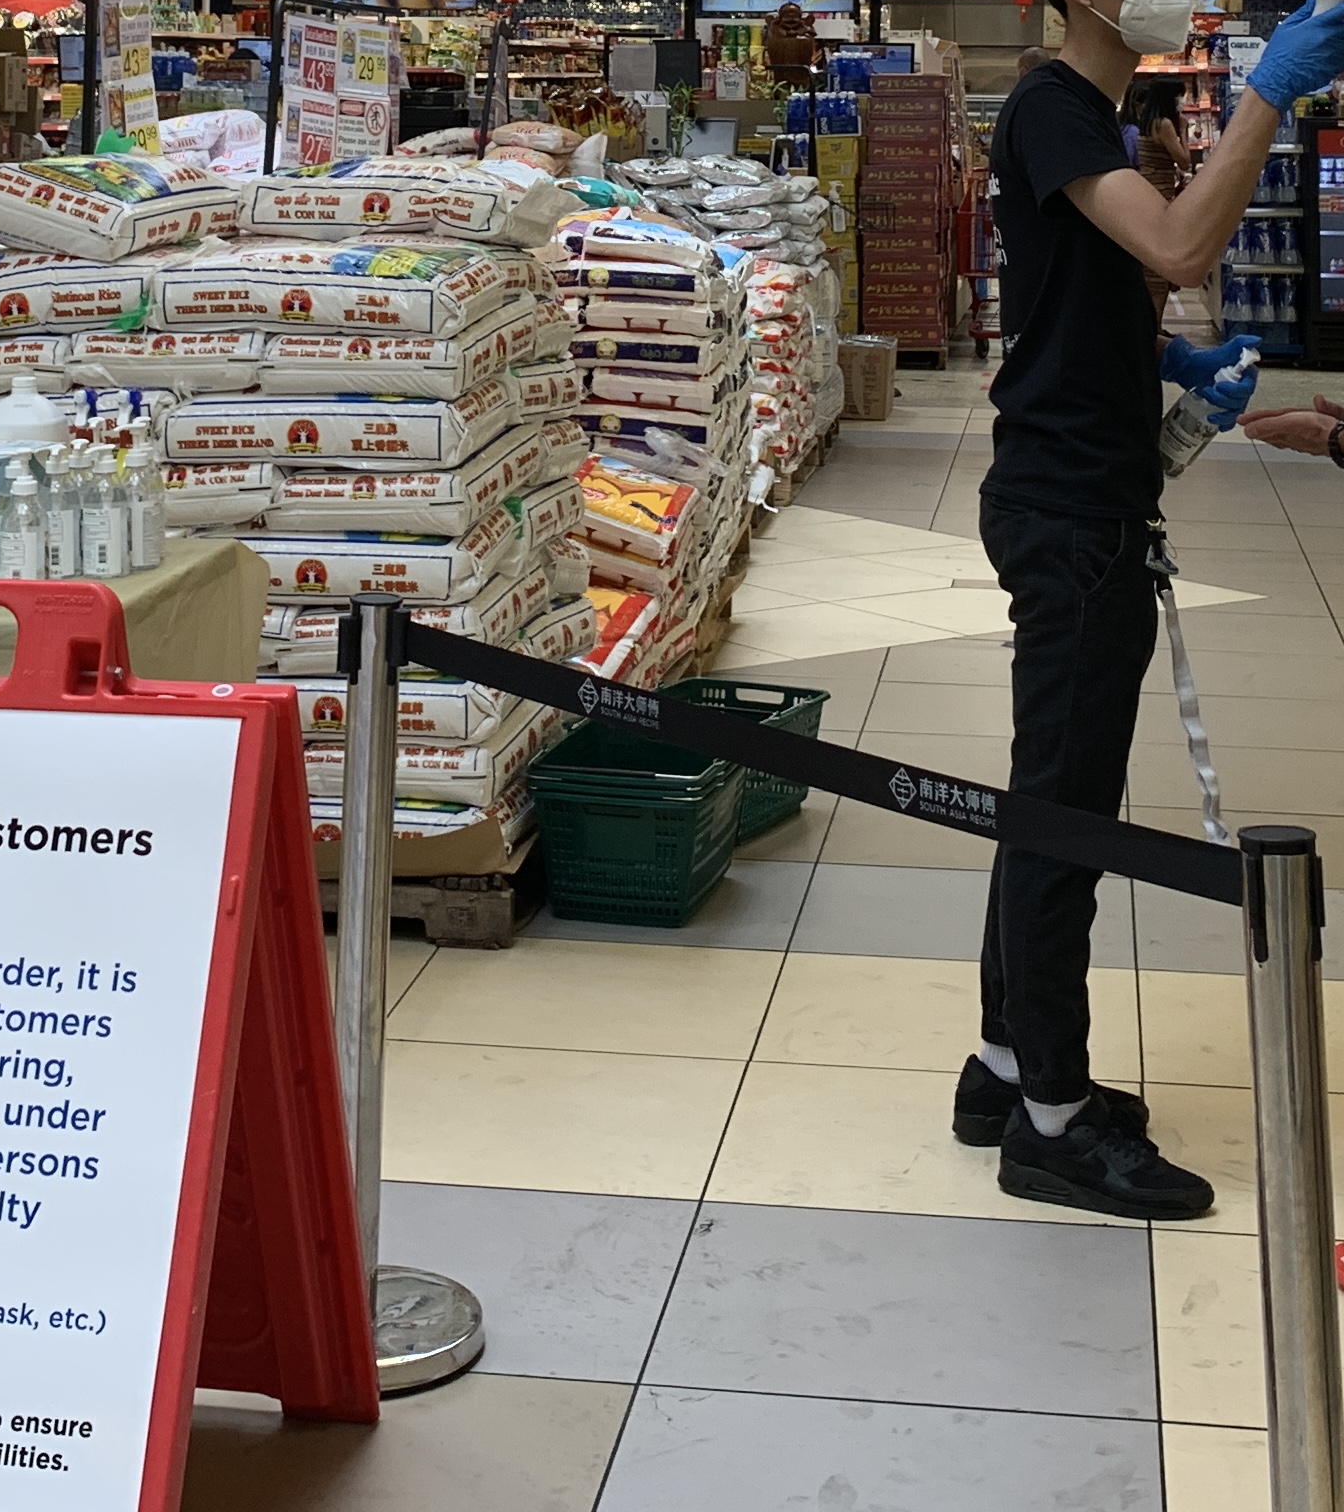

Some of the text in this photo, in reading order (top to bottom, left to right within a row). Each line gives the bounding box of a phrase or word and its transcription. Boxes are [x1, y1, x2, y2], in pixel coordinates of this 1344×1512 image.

[1230, 41, 1260, 50] OAKLEY
[123, 48, 140, 78] 43
[307, 60, 326, 92] 43
[358, 55, 386, 81] 29 99
[304, 134, 323, 165] 27
[278, 209, 336, 220] BA CON NAI
[176, 437, 274, 450] THREE DEER BRAND
[195, 424, 255, 436] SWEET RICE
[918, 799, 997, 830] SOUTH ASIA RECIPE
[78, 961, 100, 990] it
[112, 963, 136, 992] is
[4, 1100, 106, 1131] under
[49, 1308, 106, 1335] etc.)
[11, 1416, 92, 1438] ensure
